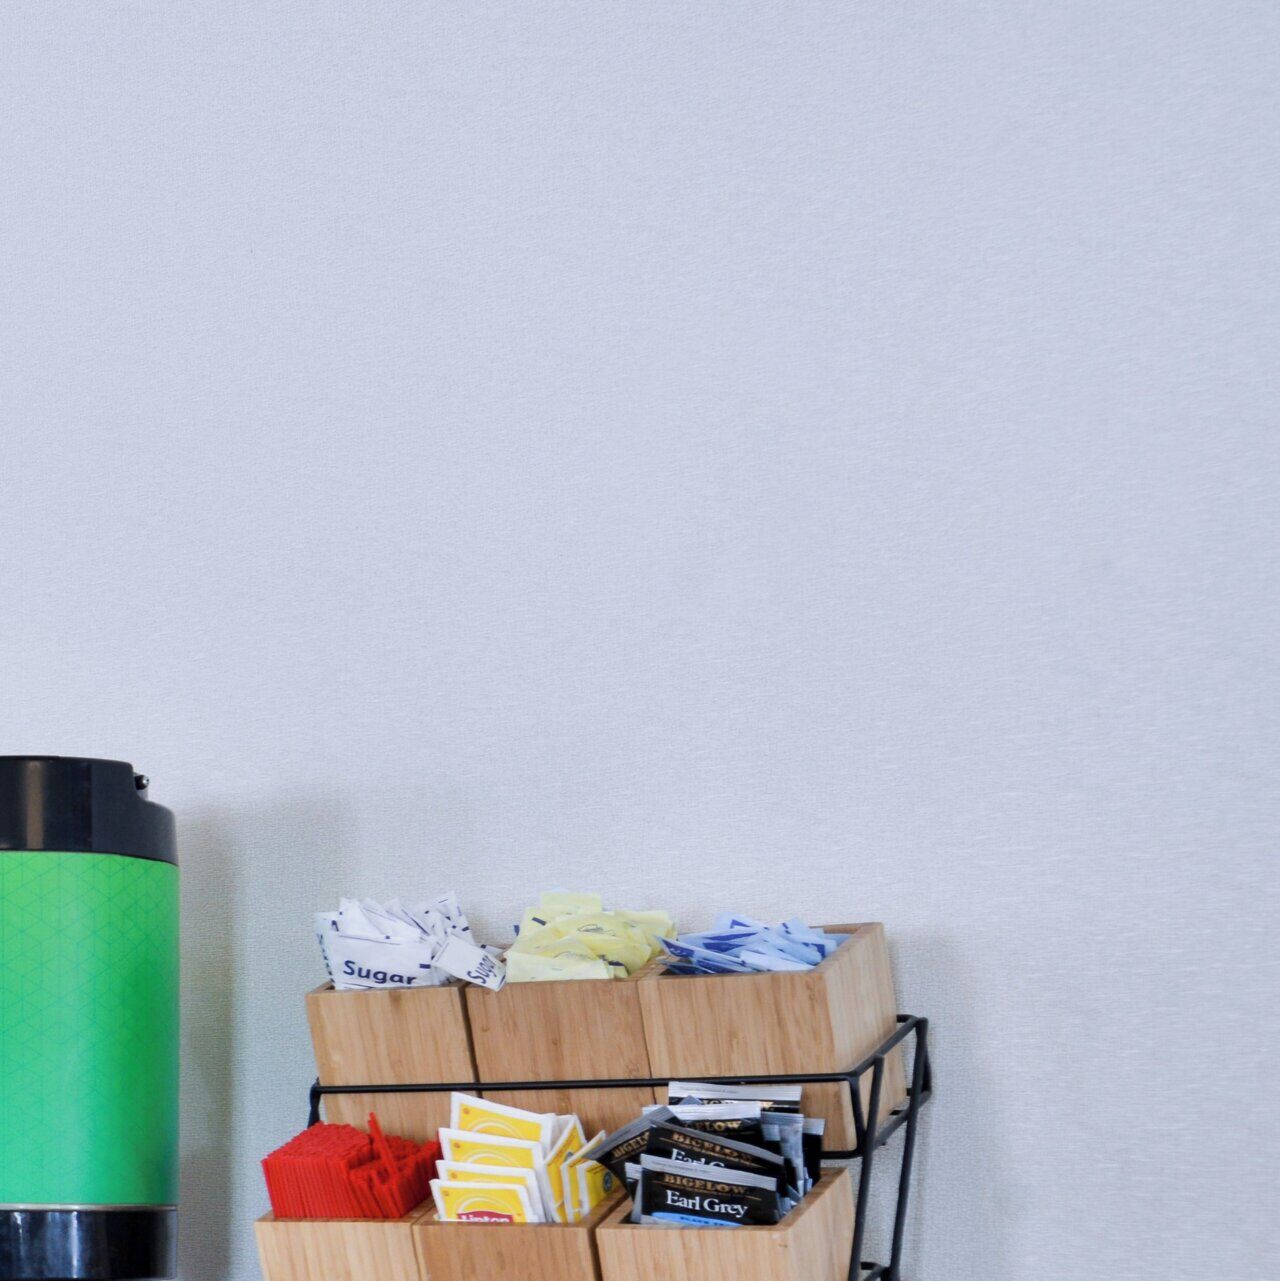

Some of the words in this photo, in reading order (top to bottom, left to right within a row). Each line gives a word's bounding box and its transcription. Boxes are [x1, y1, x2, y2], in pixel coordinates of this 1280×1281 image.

[342, 960, 417, 985] Sugar
[466, 954, 497, 984] Sugar
[663, 1174, 746, 1195] BIGELOW
[665, 1190, 700, 1210] Earl
[703, 1198, 749, 1219] Grey
